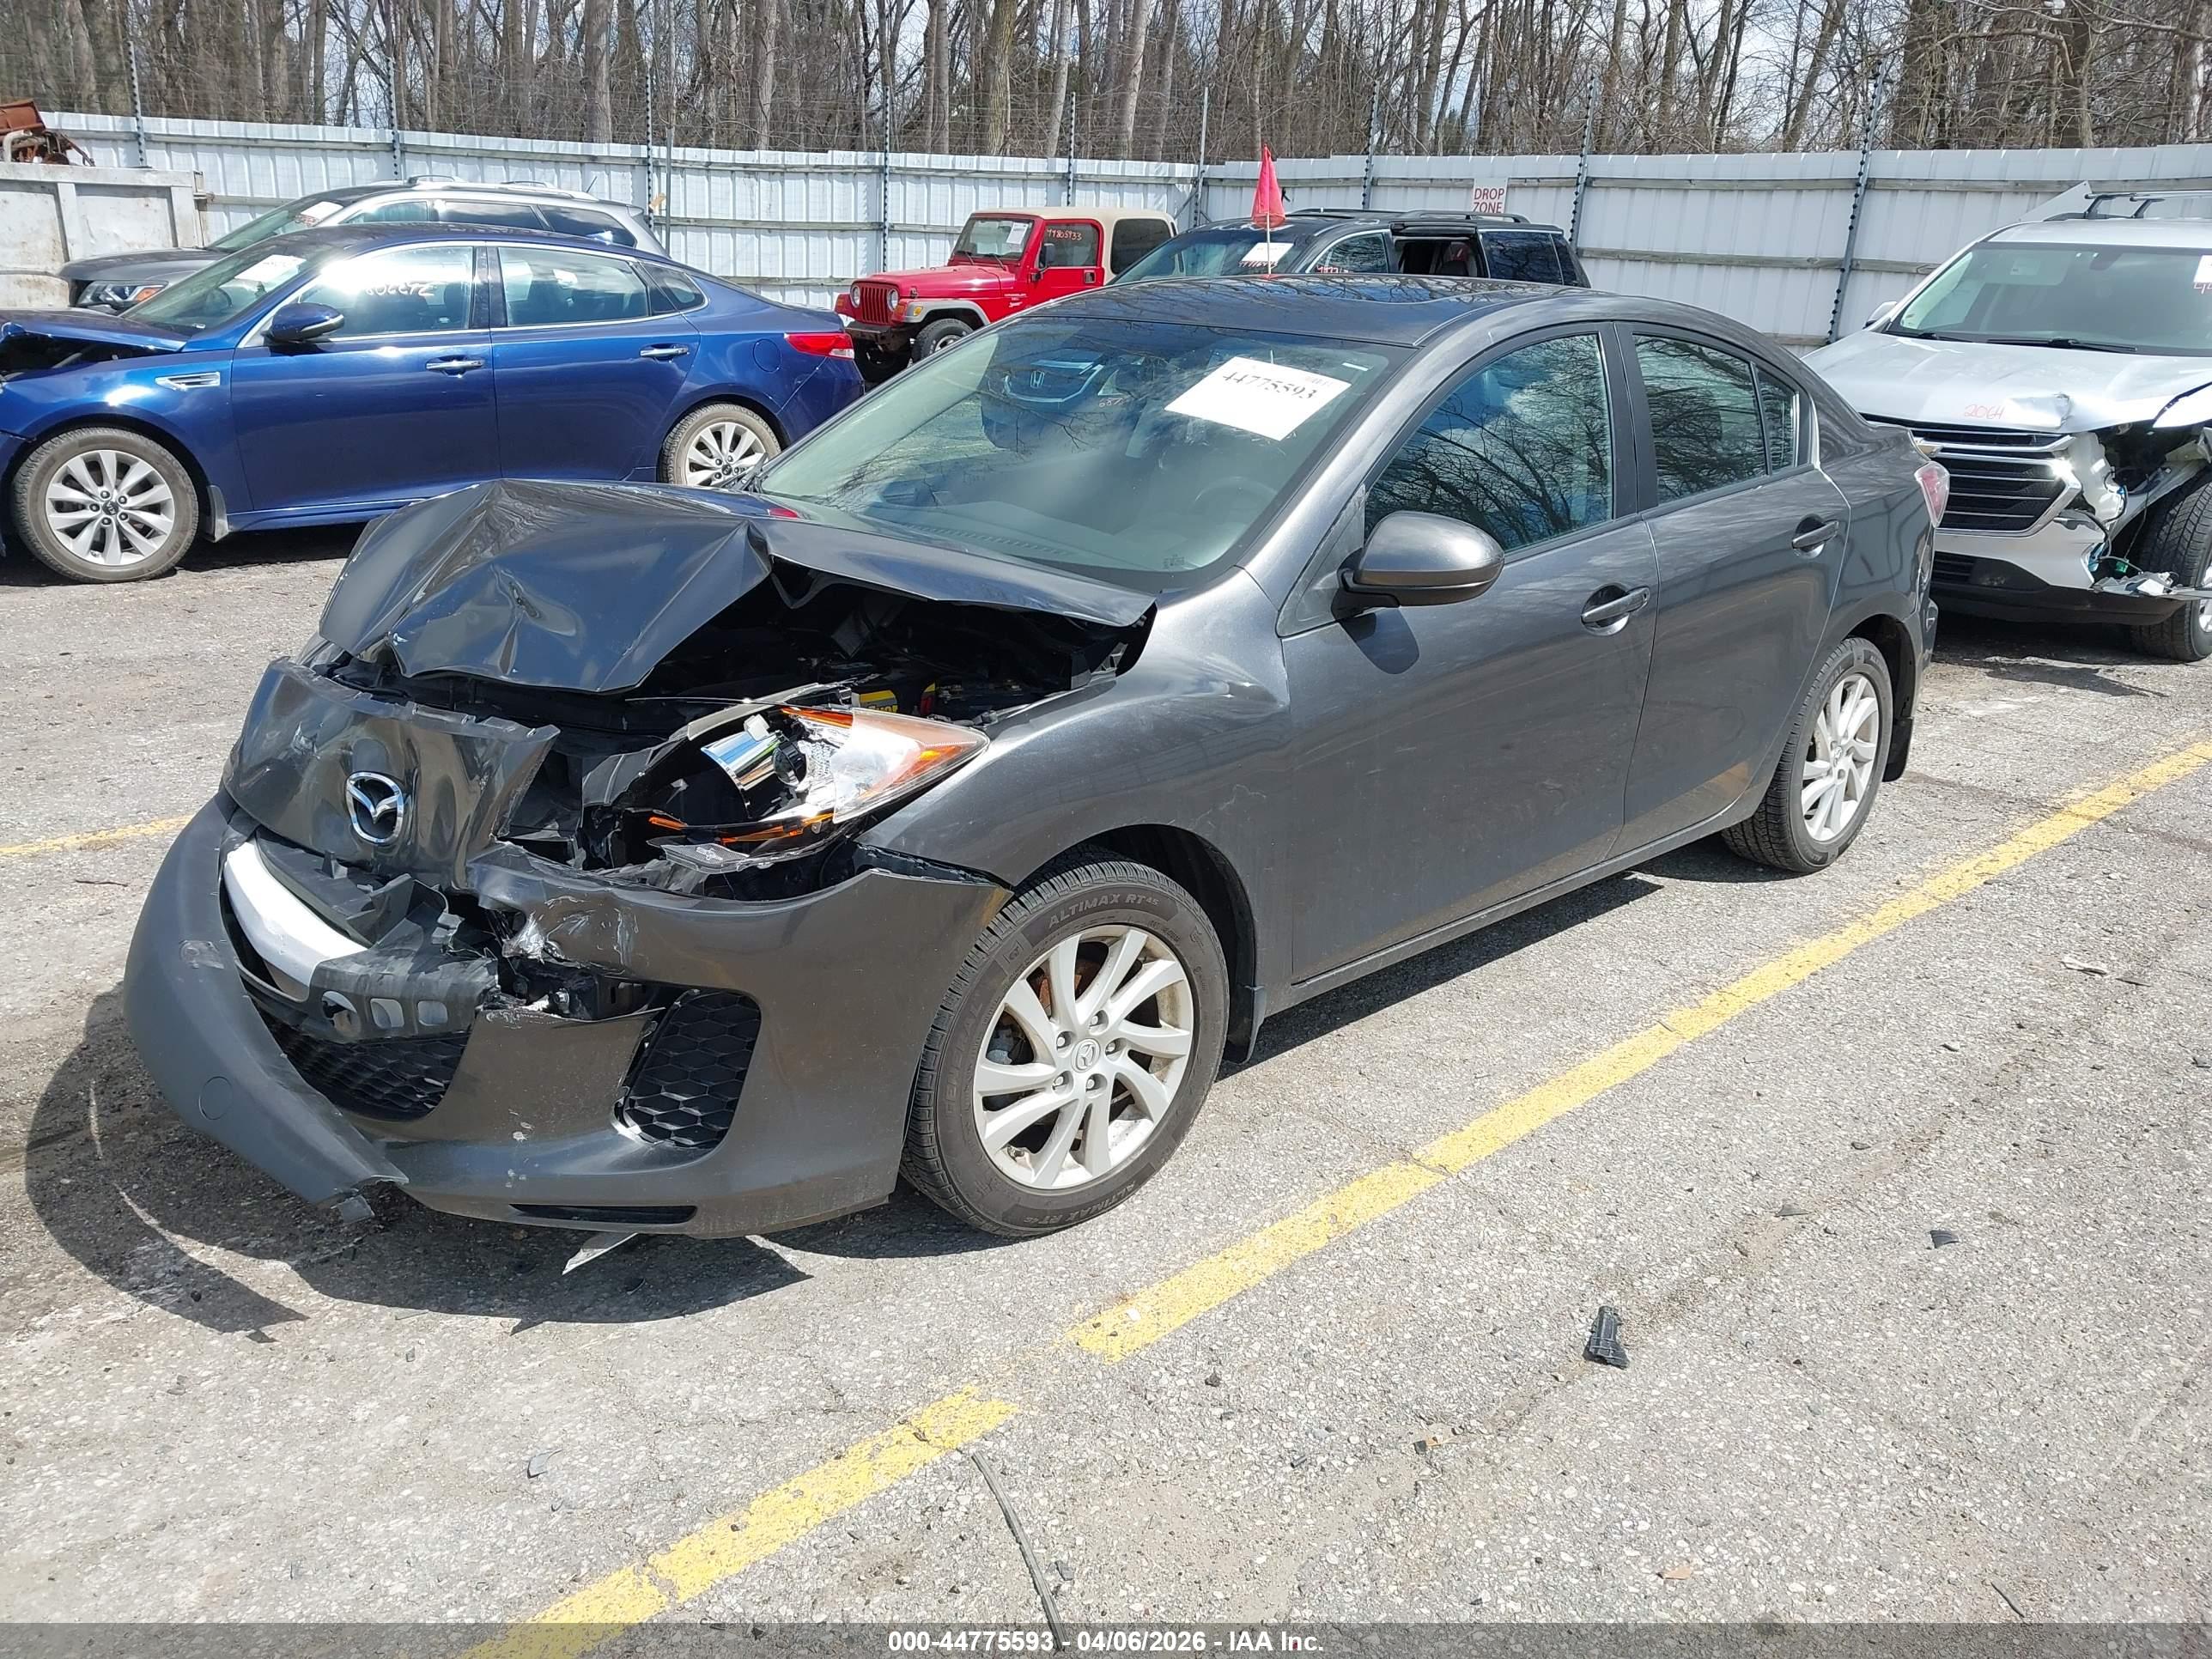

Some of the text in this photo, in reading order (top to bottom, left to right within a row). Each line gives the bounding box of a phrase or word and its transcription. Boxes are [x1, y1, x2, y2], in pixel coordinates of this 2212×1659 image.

[1474, 188, 1505, 200] DROP
[1473, 202, 1503, 214] ZONE
[1222, 371, 1317, 398] 44775593
[1048, 894, 1120, 928] ALTIMAX
